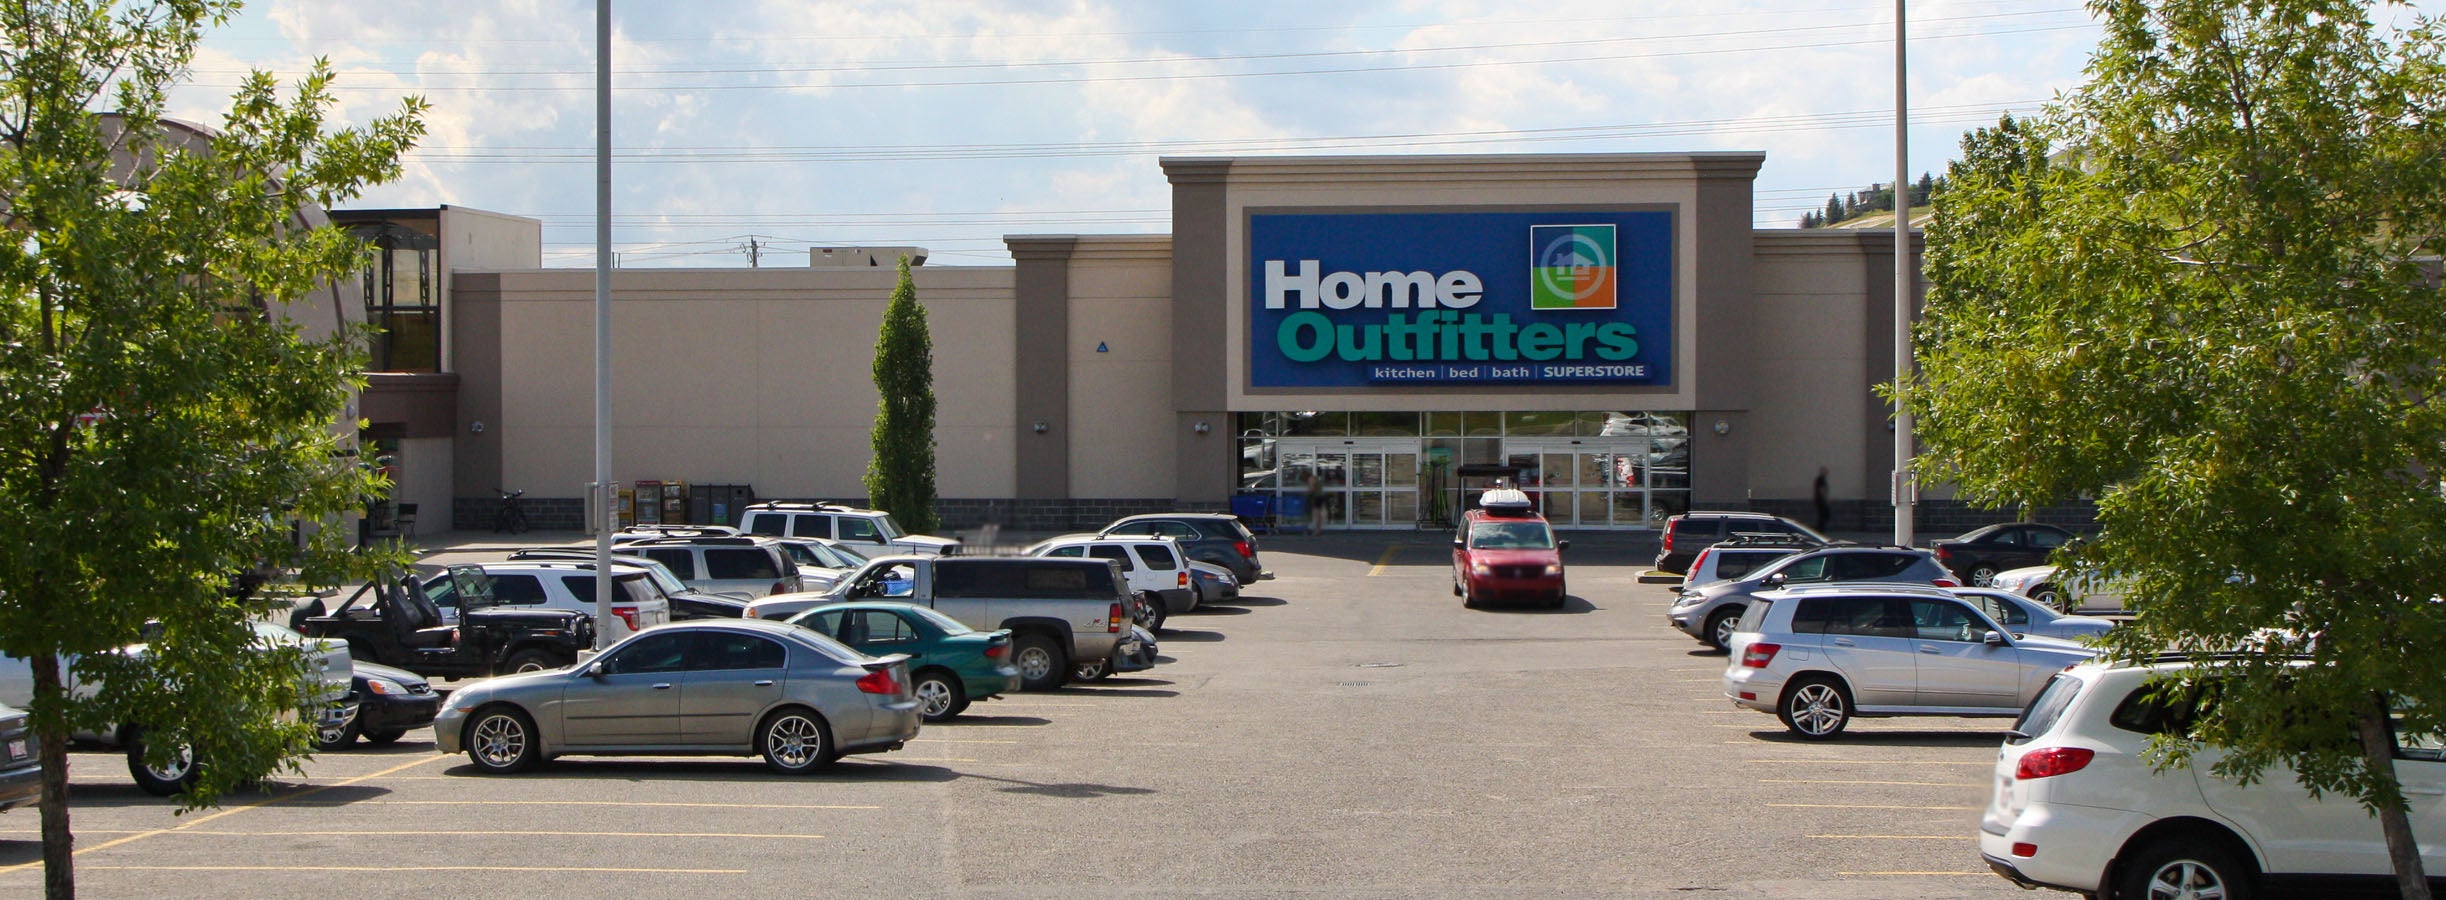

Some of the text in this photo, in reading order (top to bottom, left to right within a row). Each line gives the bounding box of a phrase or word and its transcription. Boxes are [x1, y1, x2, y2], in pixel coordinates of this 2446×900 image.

[1264, 259, 1483, 310] Home
[1277, 310, 1639, 363] Outfitters
[1374, 365, 1645, 379] kitchen bed bath SUPERSTORE
